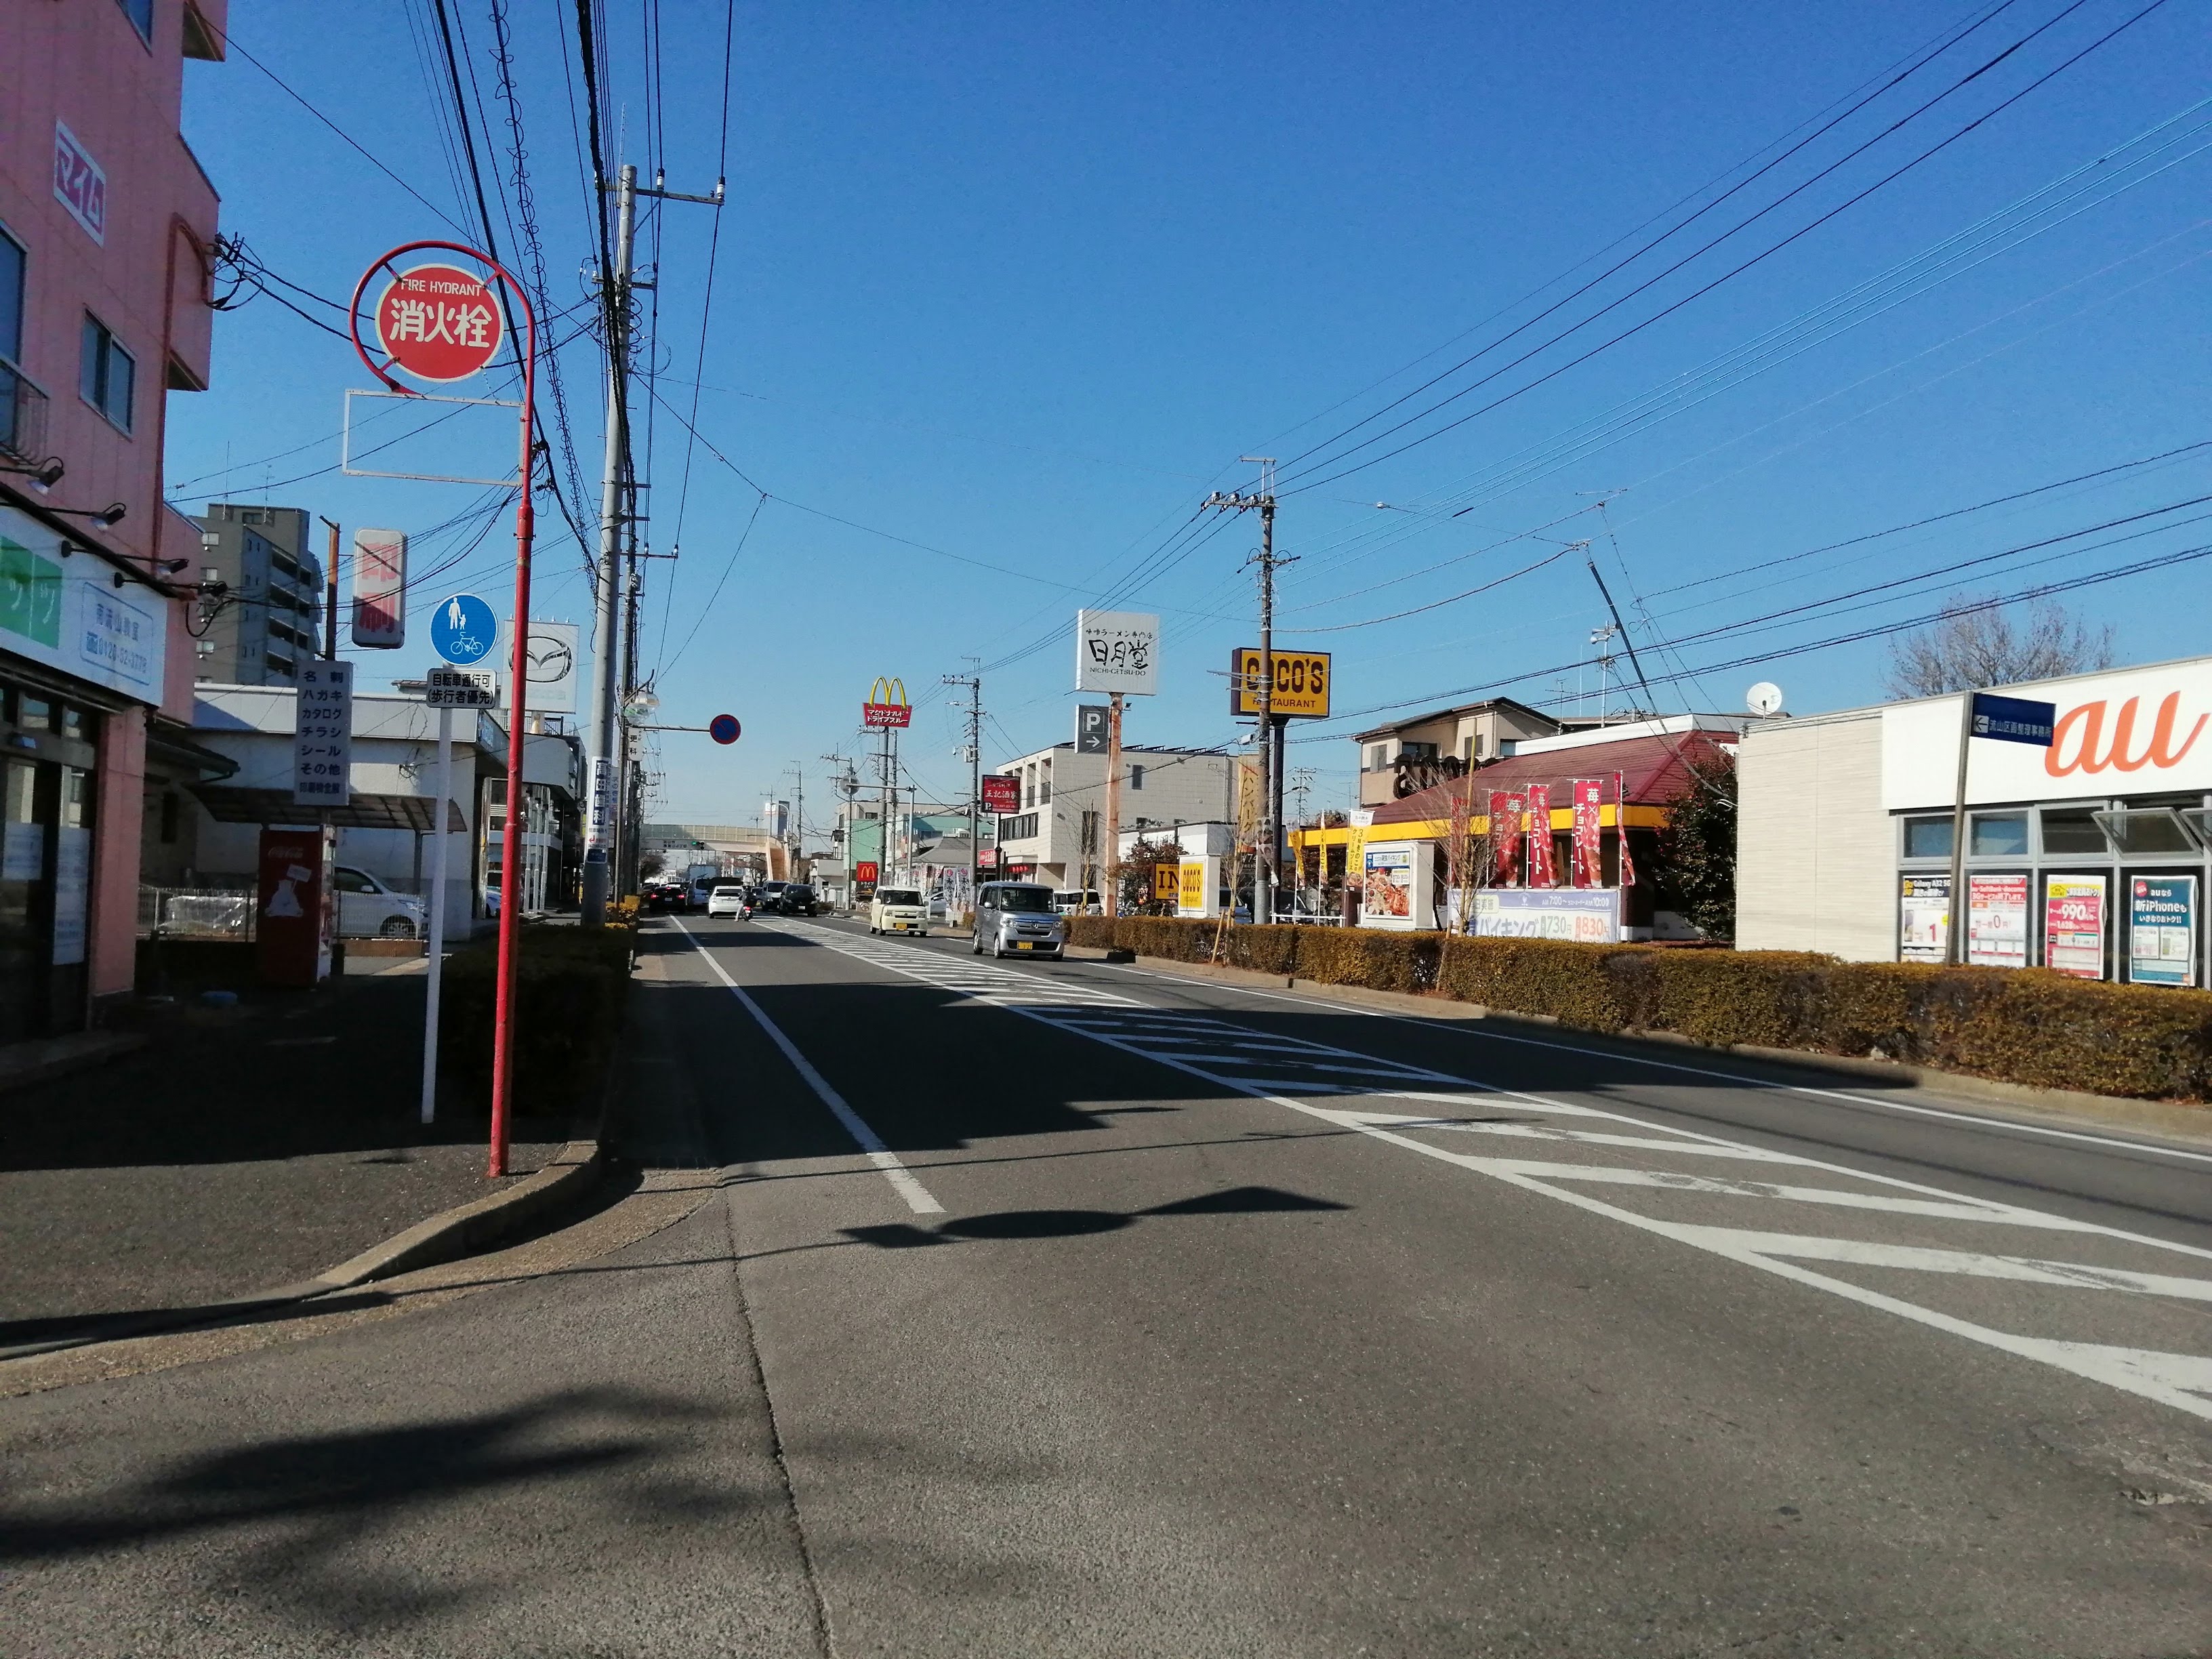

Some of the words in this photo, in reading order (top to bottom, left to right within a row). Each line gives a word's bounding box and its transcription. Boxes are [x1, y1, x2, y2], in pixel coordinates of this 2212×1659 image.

[401, 279, 426, 292] FIRE
[430, 281, 483, 296] HYDRANT
[390, 298, 493, 348] 消火栓
[359, 542, 398, 633] 印刷
[1088, 639, 1149, 670] 日月堂
[304, 670, 344, 683] 名刺
[433, 674, 491, 687] 自転車通行可
[303, 689, 343, 701] ハガキ
[428, 689, 493, 705] (歩行者優先)
[302, 708, 342, 720] カタログ
[867, 716, 908, 724] ドライブスルー
[1086, 713, 1101, 732] P
[302, 726, 342, 738] チラシ
[2045, 691, 2211, 777] au
[302, 745, 342, 757] シール
[301, 763, 341, 775] その他
[1533, 806, 1543, 875] チョコレート
[1576, 803, 1586, 875] チョコレート
[2150, 889, 2172, 897] auなら
[2135, 899, 2187, 913] 新iPhoneも
